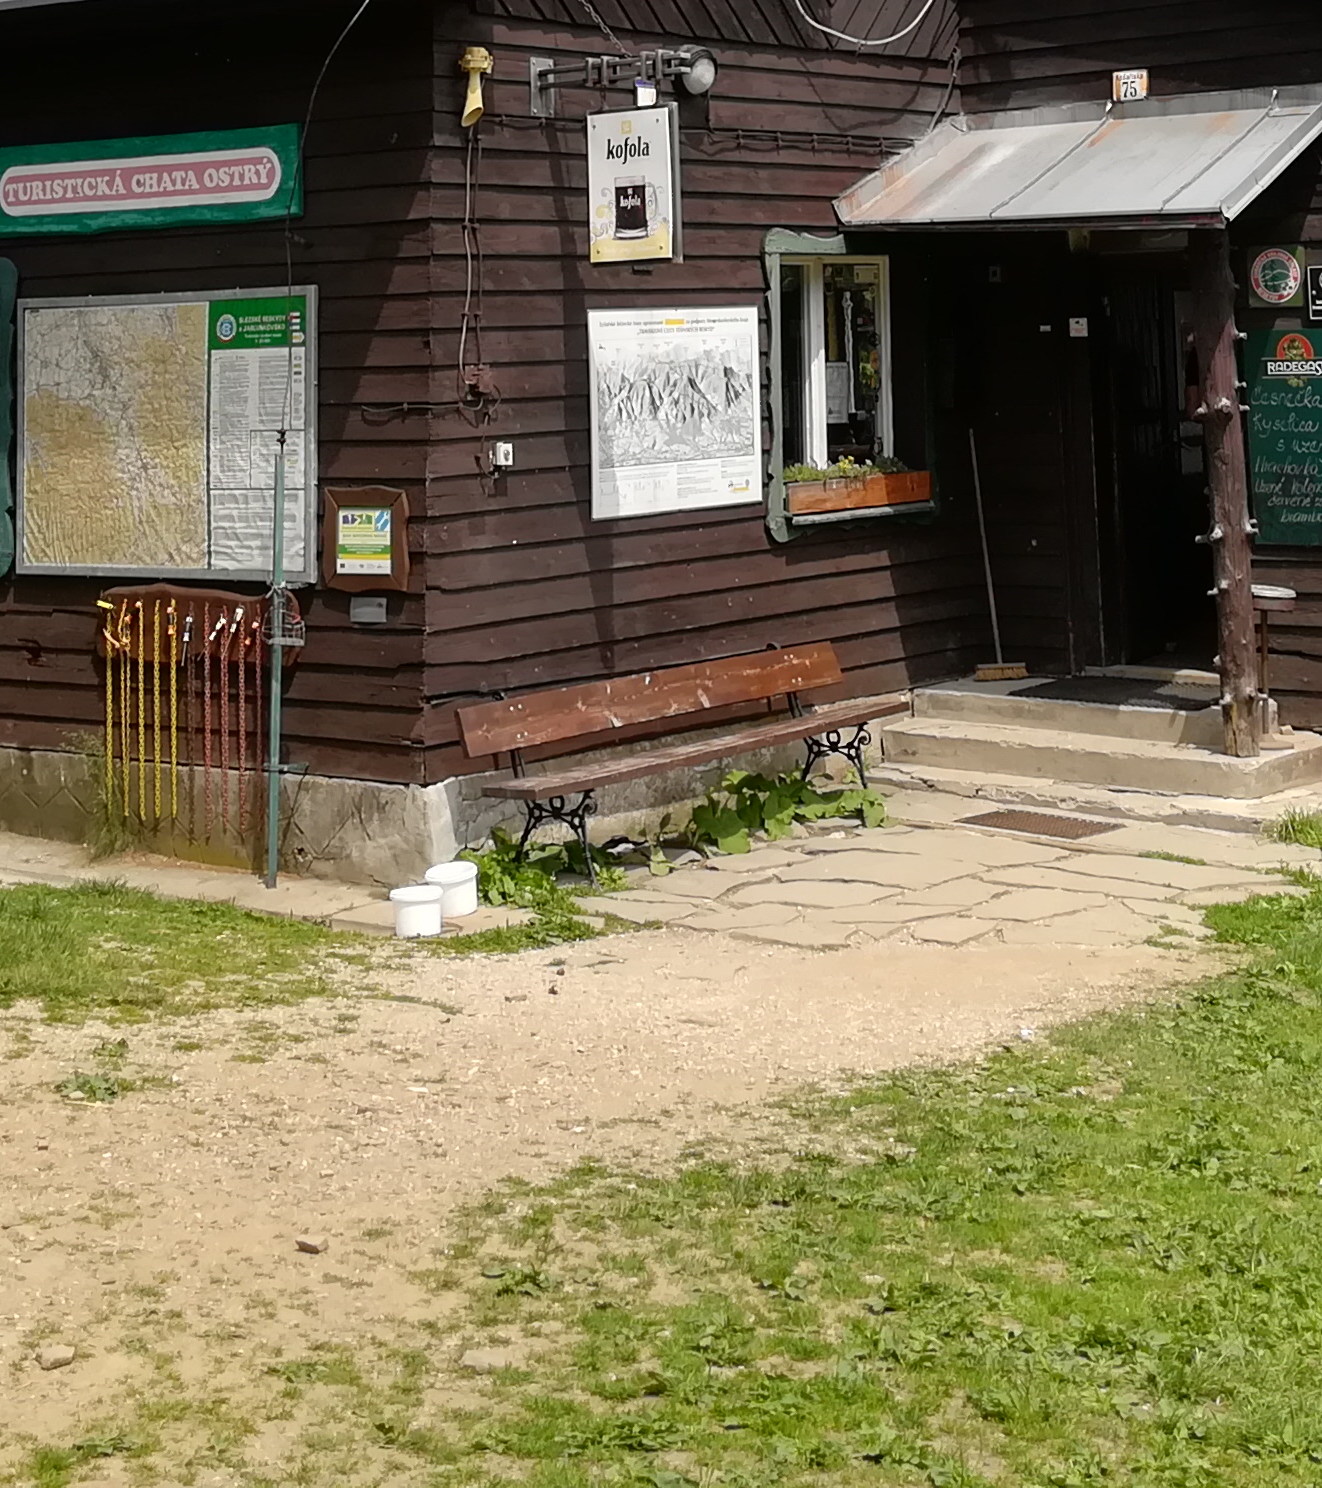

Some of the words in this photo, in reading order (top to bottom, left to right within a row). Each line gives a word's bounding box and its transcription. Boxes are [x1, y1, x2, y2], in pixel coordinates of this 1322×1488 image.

[1122, 81, 1137, 98] 75
[606, 136, 650, 165] kofola
[5, 170, 126, 203] TURISTICKÁ
[131, 170, 199, 193] CHATA
[203, 158, 272, 187] OSTRÝ
[620, 194, 641, 210] kofola
